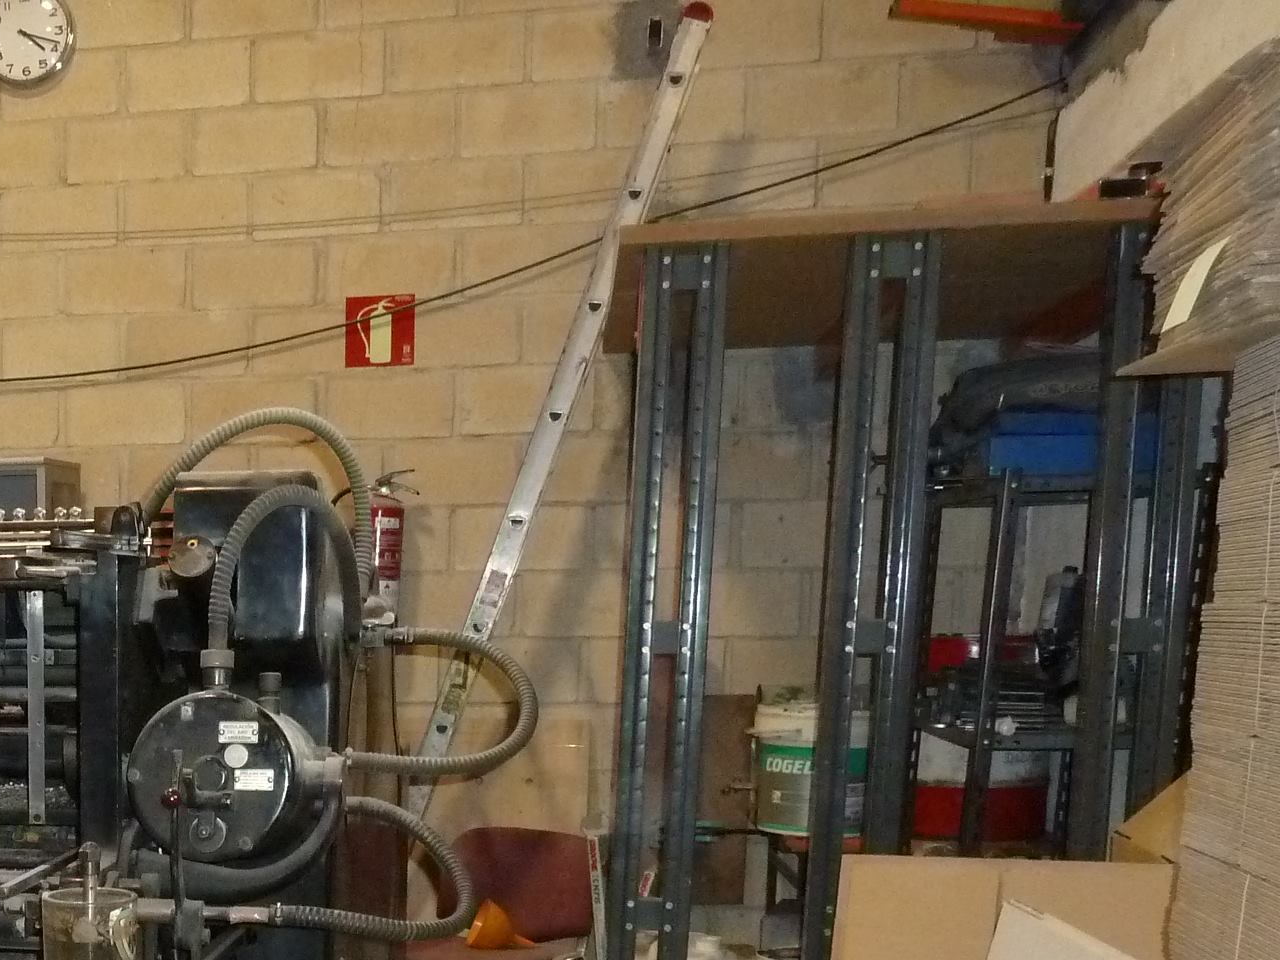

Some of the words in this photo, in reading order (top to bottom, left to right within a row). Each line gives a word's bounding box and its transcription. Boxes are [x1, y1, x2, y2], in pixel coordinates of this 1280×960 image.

[3, 2, 11, 11] 11
[49, 8, 58, 17] 2
[54, 25, 64, 35] 3
[51, 44, 59, 53] 4
[5, 63, 14, 74] 7
[38, 59, 48, 69] 5
[22, 66, 32, 76] 6
